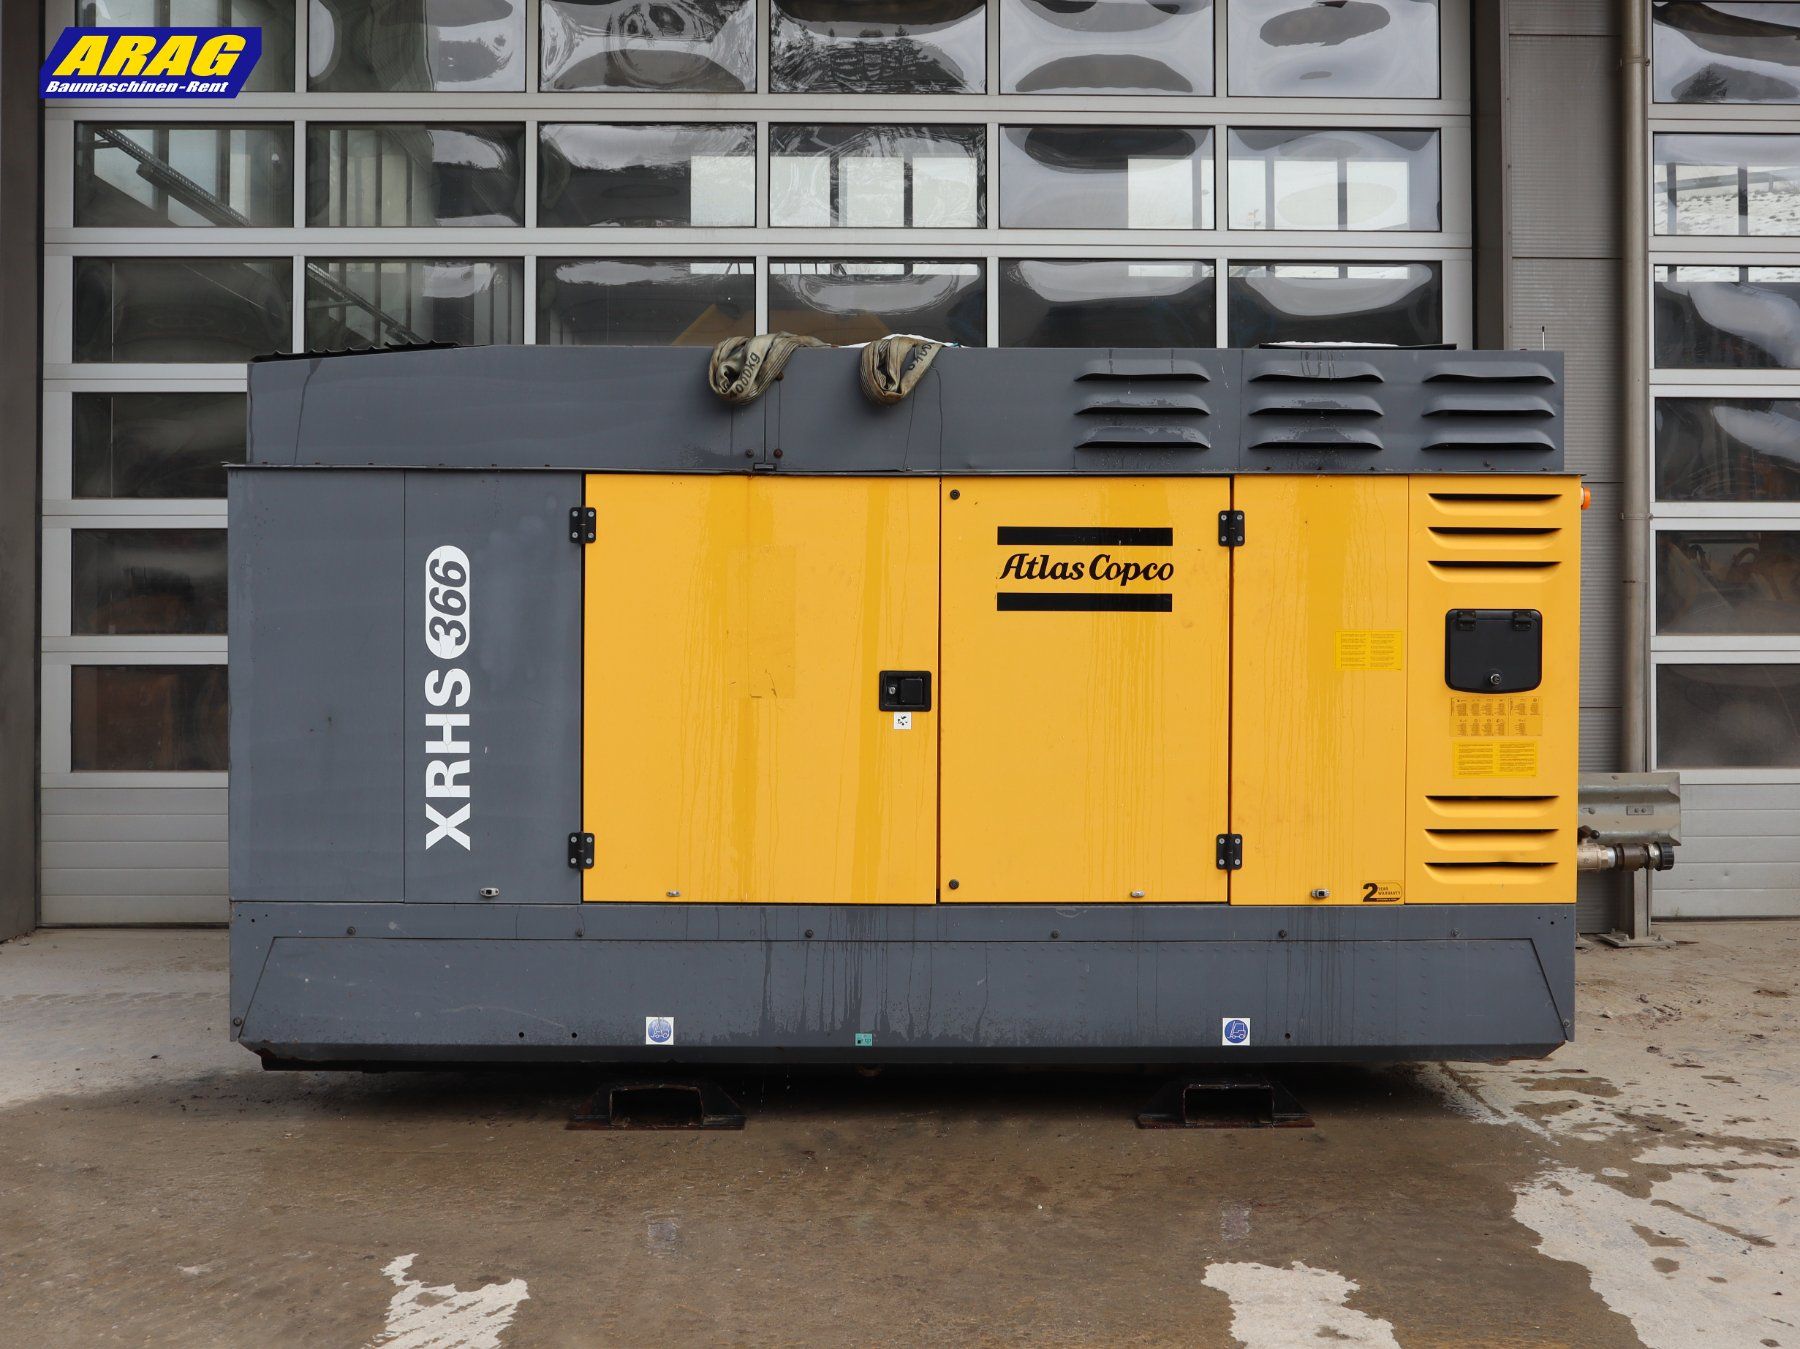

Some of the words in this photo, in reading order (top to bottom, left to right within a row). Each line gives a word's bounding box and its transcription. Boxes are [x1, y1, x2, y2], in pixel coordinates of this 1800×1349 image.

[999, 553, 1085, 580] Atlas
[1089, 553, 1174, 586] Copco
[428, 558, 467, 647] 366
[424, 668, 471, 851] XRHS
[1363, 883, 1377, 902] 2
